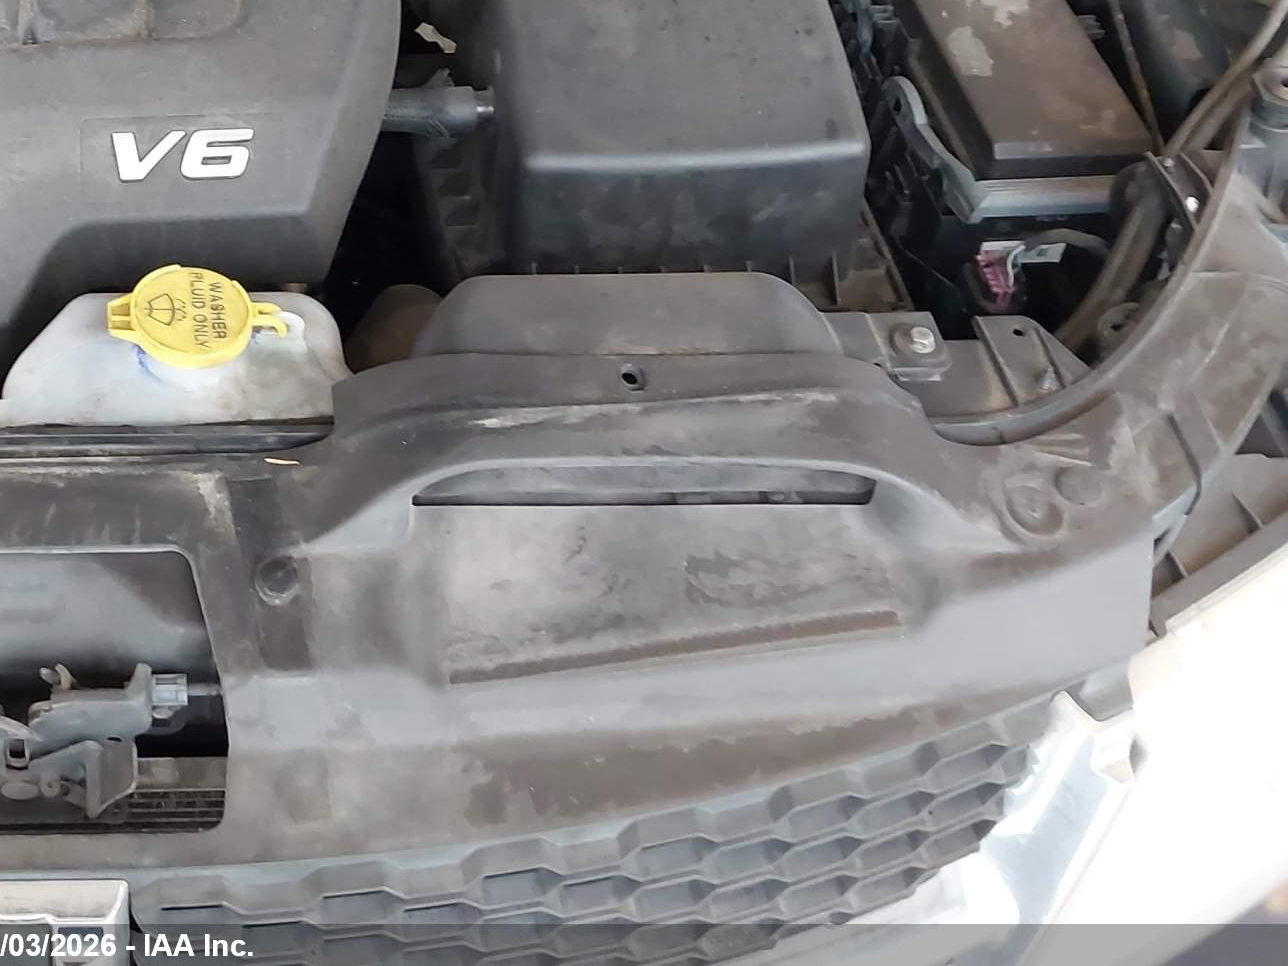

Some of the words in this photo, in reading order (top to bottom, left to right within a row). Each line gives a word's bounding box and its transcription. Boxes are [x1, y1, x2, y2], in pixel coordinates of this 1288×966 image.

[111, 128, 255, 182] V6
[189, 271, 206, 310] FLUID
[208, 281, 228, 340] WASHER
[192, 314, 211, 349] ONLY
